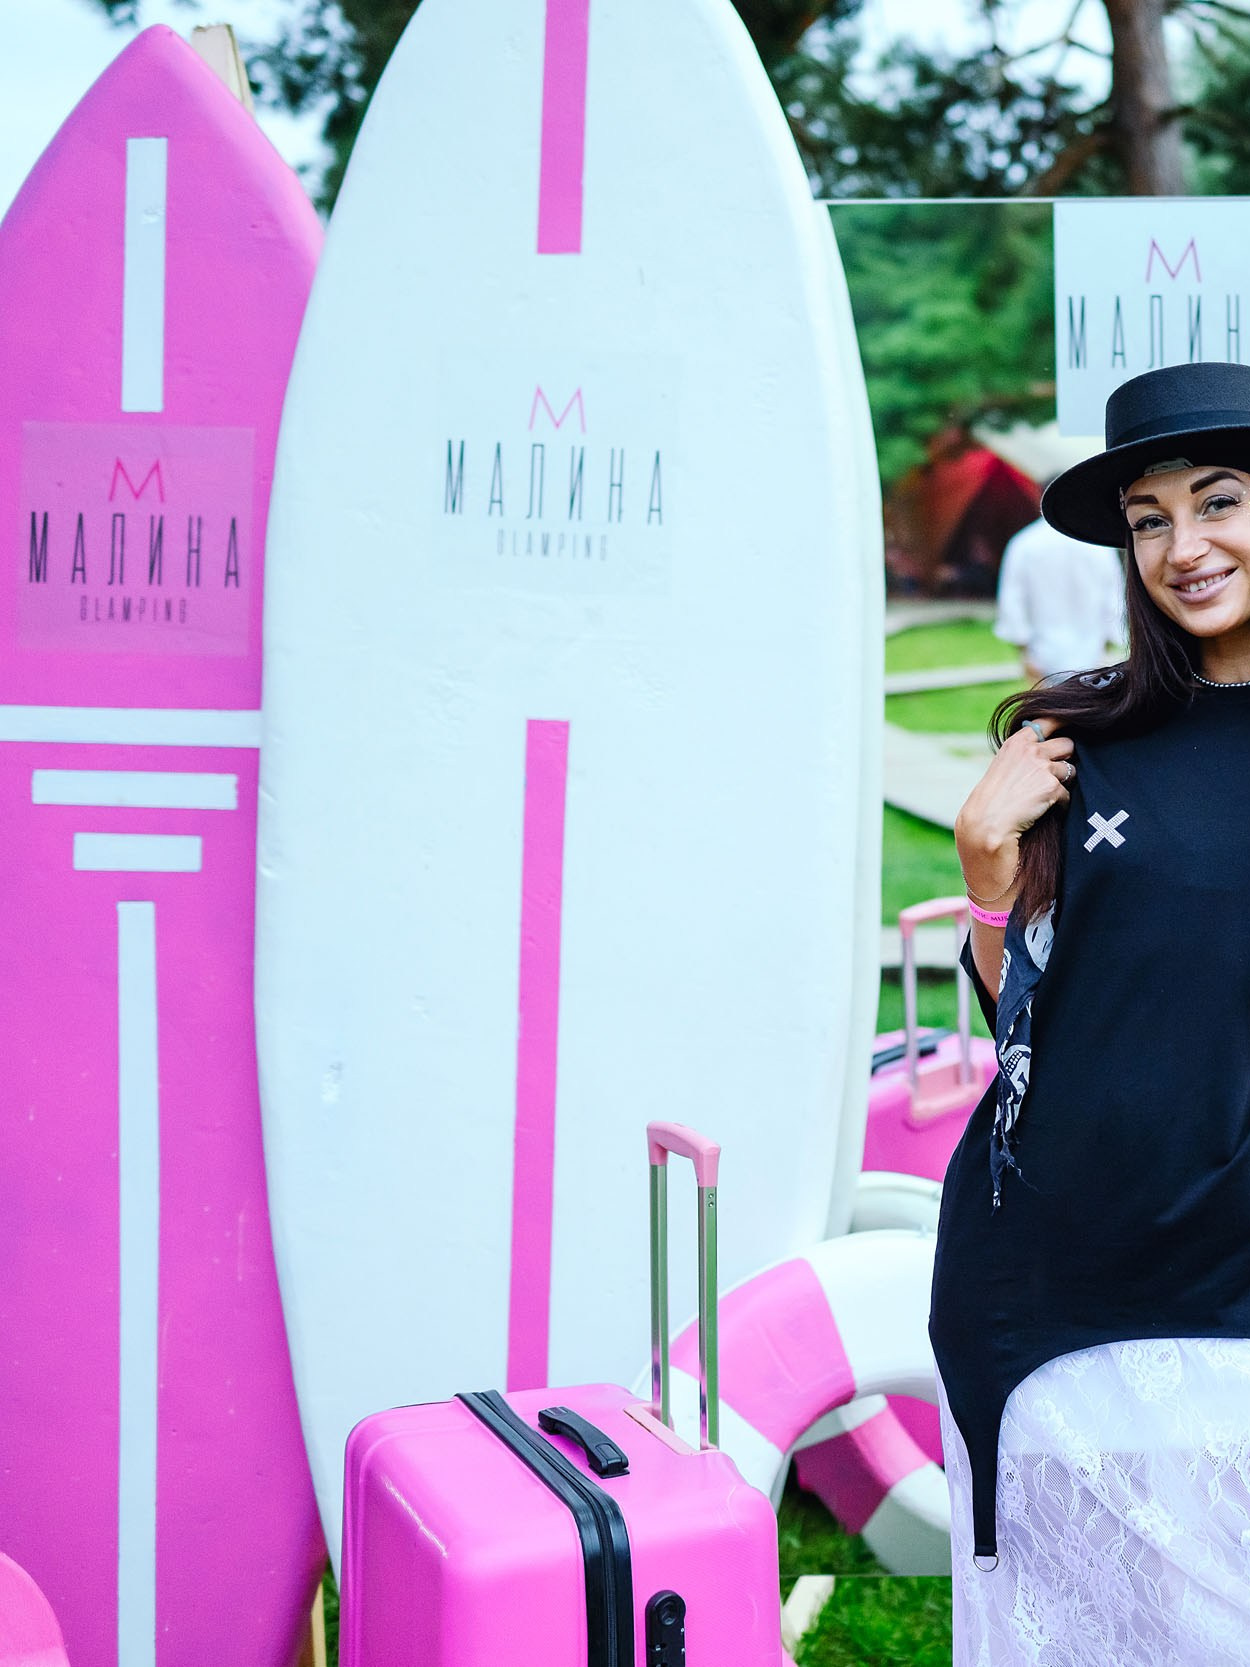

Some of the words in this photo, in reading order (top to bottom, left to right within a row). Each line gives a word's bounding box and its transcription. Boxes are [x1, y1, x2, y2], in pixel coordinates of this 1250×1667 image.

[444, 438, 663, 525] МАЛИНА
[29, 511, 240, 588] МАЛИНА
[496, 528, 608, 561] GLAMPING
[79, 595, 187, 624] GLAMPING
